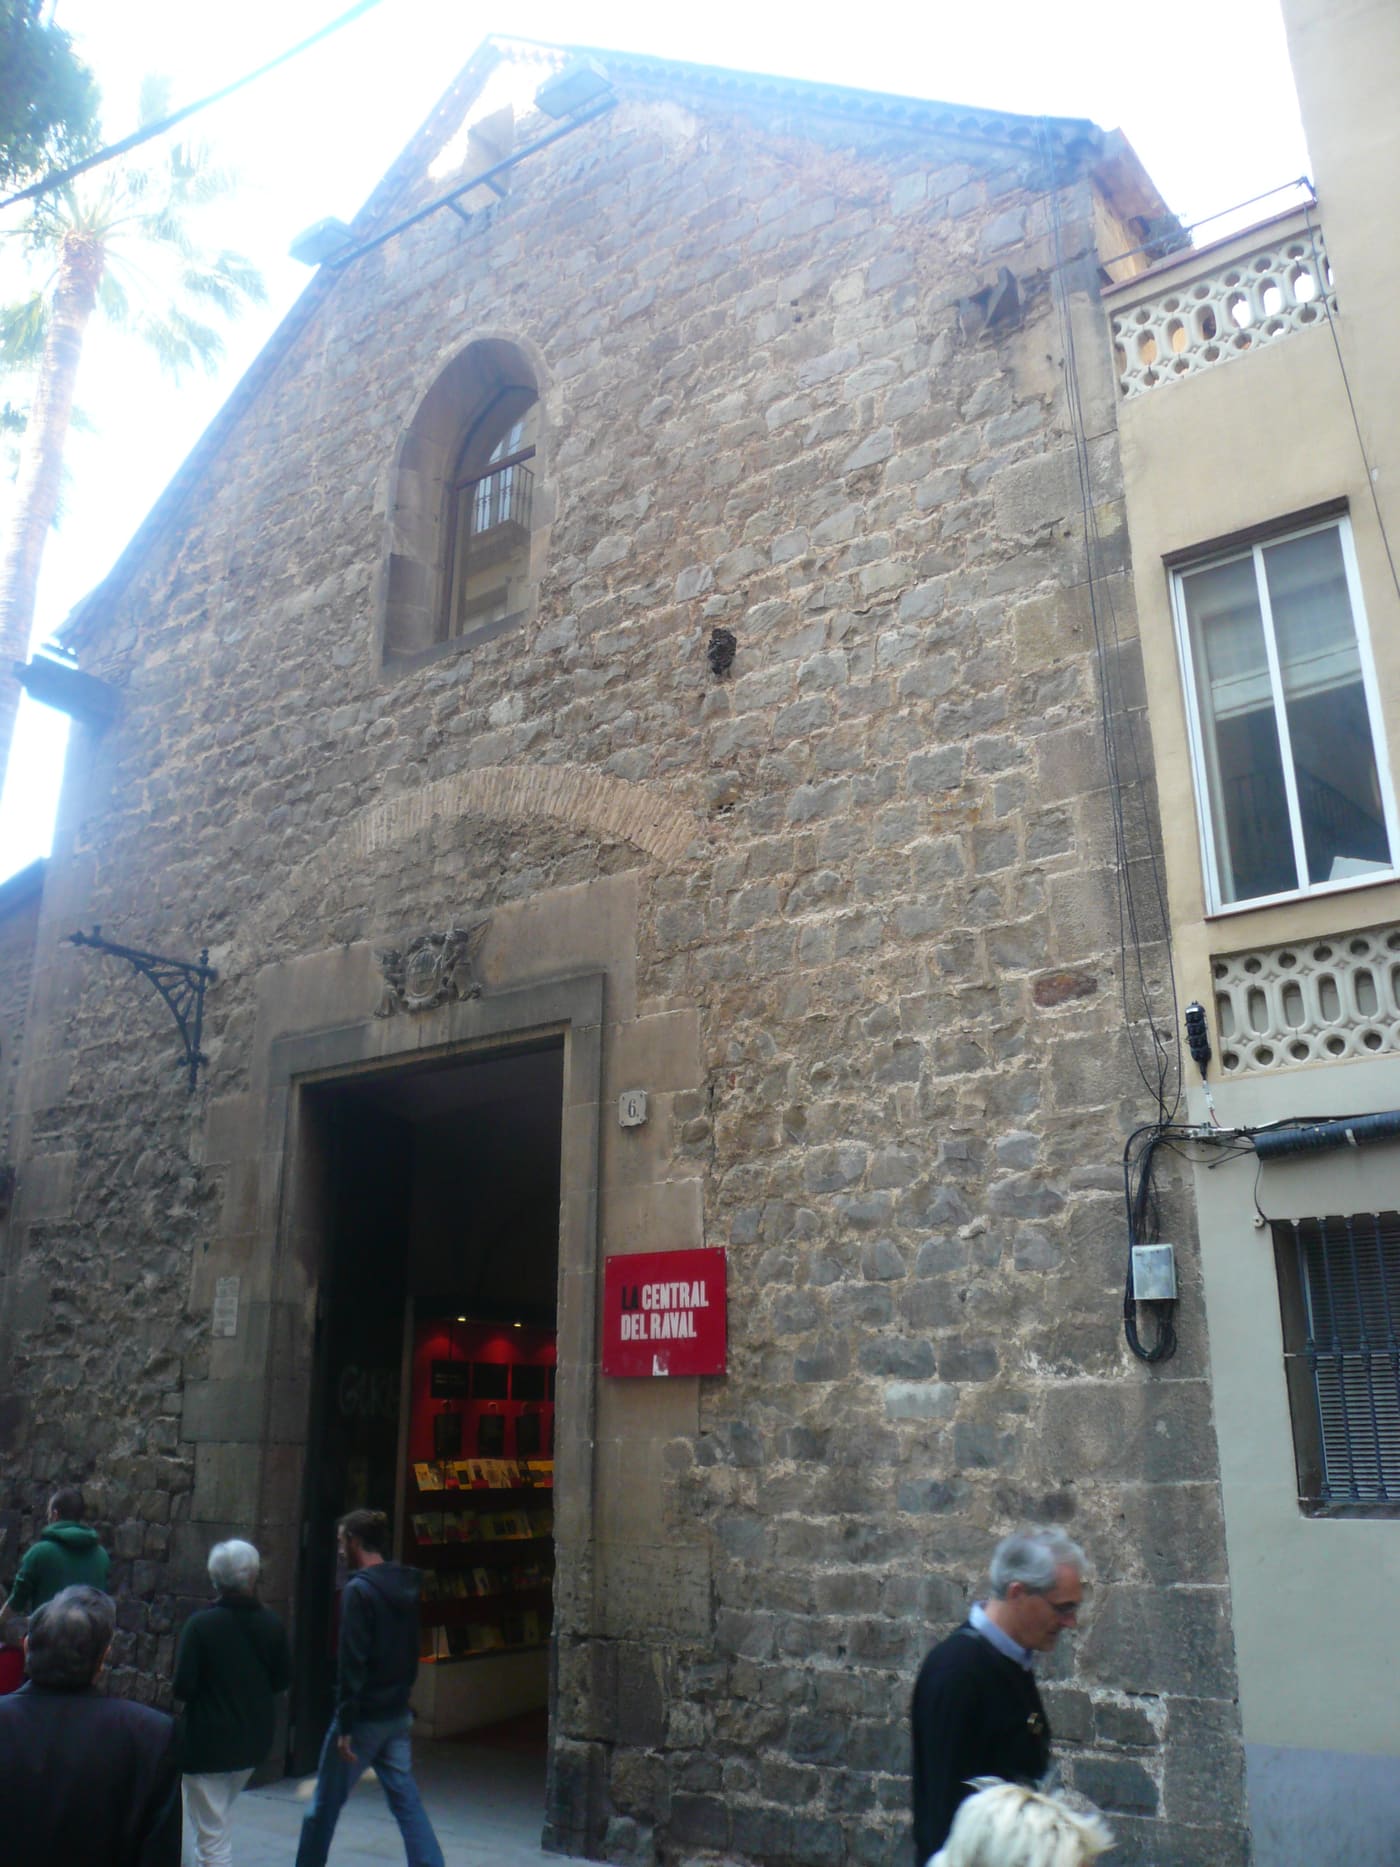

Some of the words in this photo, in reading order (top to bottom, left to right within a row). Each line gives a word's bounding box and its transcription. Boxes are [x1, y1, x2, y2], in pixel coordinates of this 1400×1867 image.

[622, 1285, 639, 1311] LA
[642, 1281, 709, 1310] CENTRAL
[620, 1313, 649, 1341] DEL
[650, 1311, 697, 1339] RAVAL
